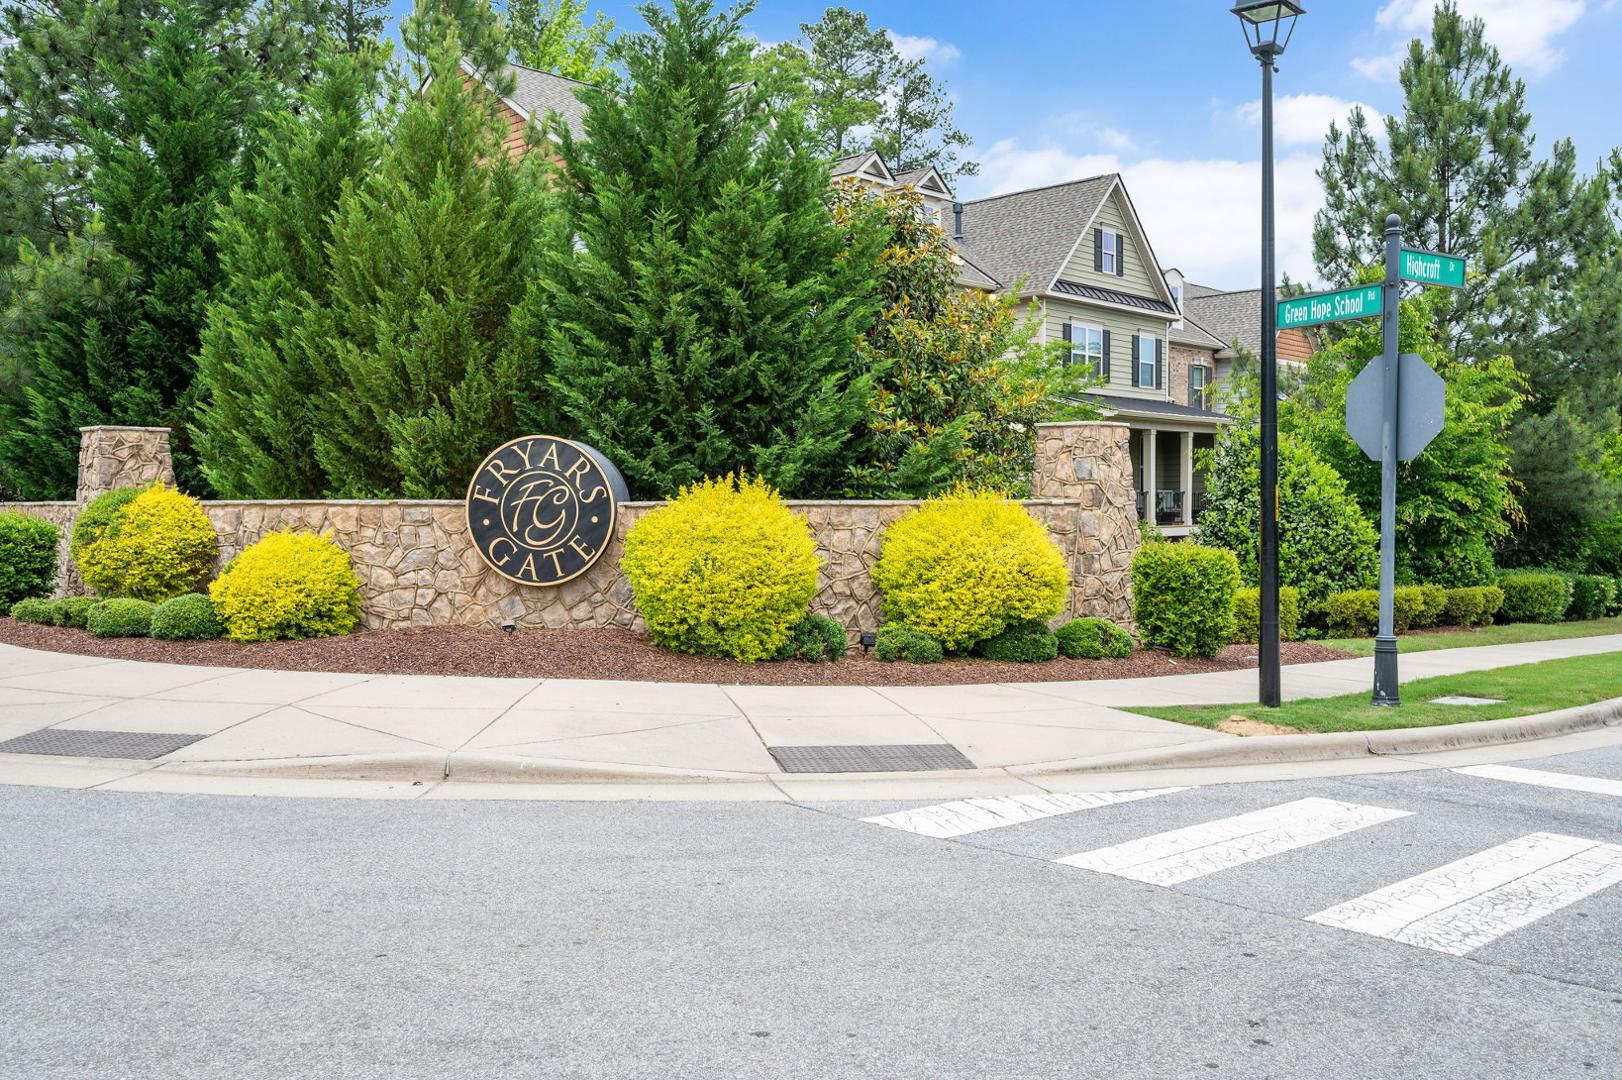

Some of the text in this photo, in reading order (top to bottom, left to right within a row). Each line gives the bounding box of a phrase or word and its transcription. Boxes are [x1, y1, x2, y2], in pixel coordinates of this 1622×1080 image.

[1406, 254, 1456, 279] Highcroft Dr
[1285, 290, 1375, 323] Green Hope School Rd
[472, 440, 607, 506] FRYARS
[510, 479, 570, 545] FG
[488, 534, 596, 581] GATE
